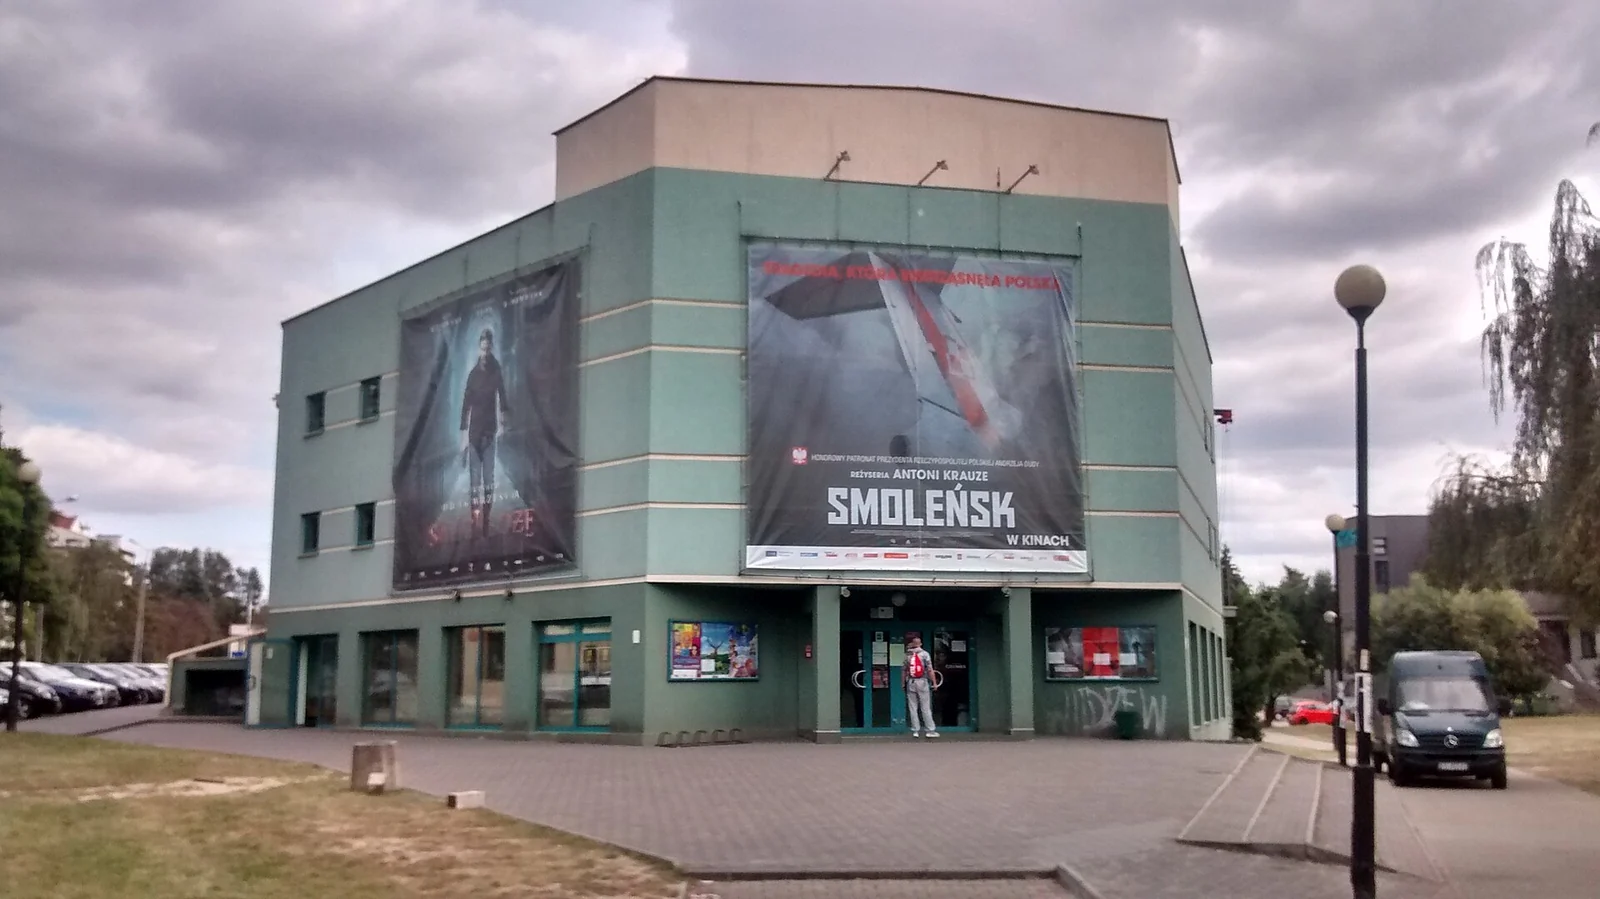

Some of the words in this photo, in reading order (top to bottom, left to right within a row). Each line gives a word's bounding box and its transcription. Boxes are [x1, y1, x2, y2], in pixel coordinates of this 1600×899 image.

[850, 469, 890, 479] REŻYSERIA
[892, 468, 940, 480] ANTONI
[943, 469, 989, 482] KRAUZE
[827, 482, 1016, 528] SMOLEŃSK
[1006, 534, 1020, 545] W
[1022, 534, 1070, 547] KINACH
